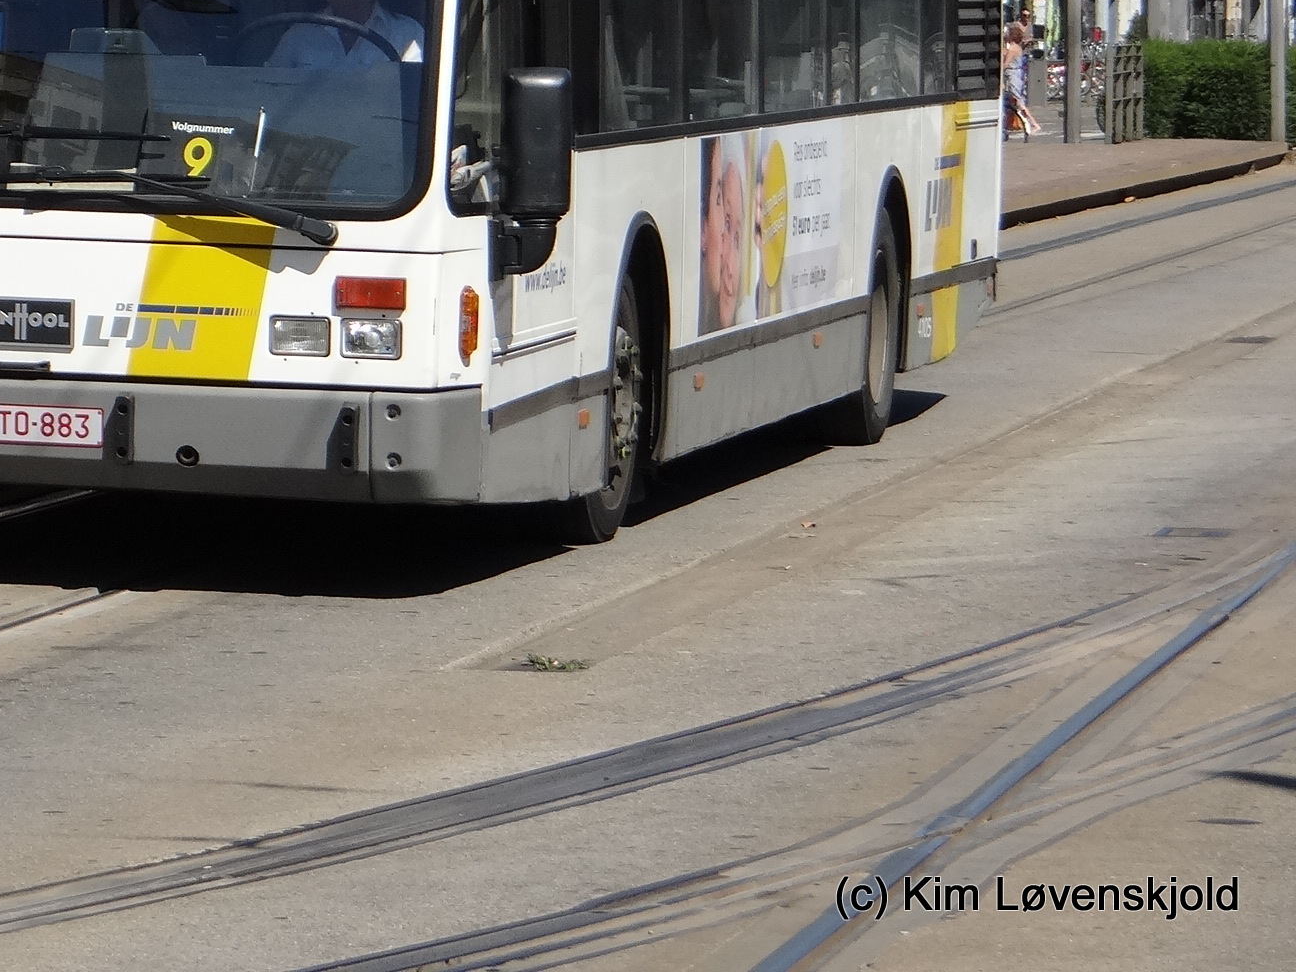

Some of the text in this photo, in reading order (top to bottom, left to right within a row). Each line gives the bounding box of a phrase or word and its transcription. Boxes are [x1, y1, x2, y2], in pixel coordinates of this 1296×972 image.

[171, 120, 235, 135] Volgnummer
[184, 136, 213, 176] 9
[115, 302, 134, 313] DE
